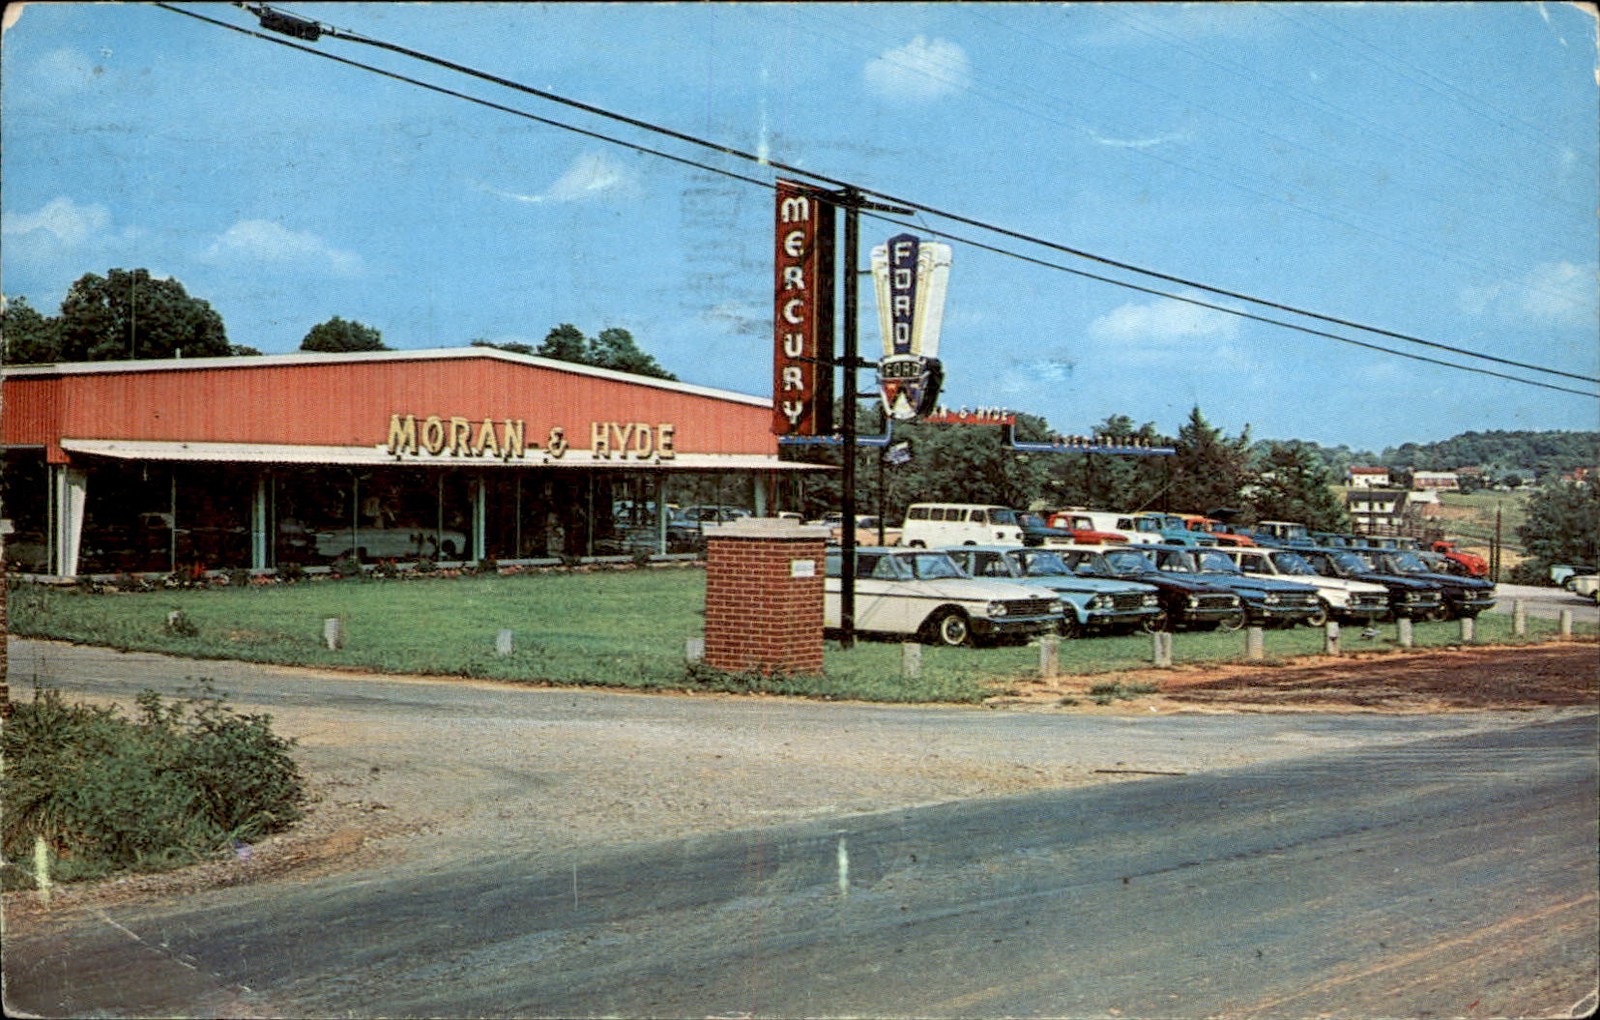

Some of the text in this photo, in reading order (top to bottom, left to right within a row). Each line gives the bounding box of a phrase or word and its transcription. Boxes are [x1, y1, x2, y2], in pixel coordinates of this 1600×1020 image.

[781, 196, 809, 424] MERCURY
[895, 241, 912, 344] FORD
[885, 362, 921, 377] FORD
[388, 414, 676, 460] MORAN & HYDE
